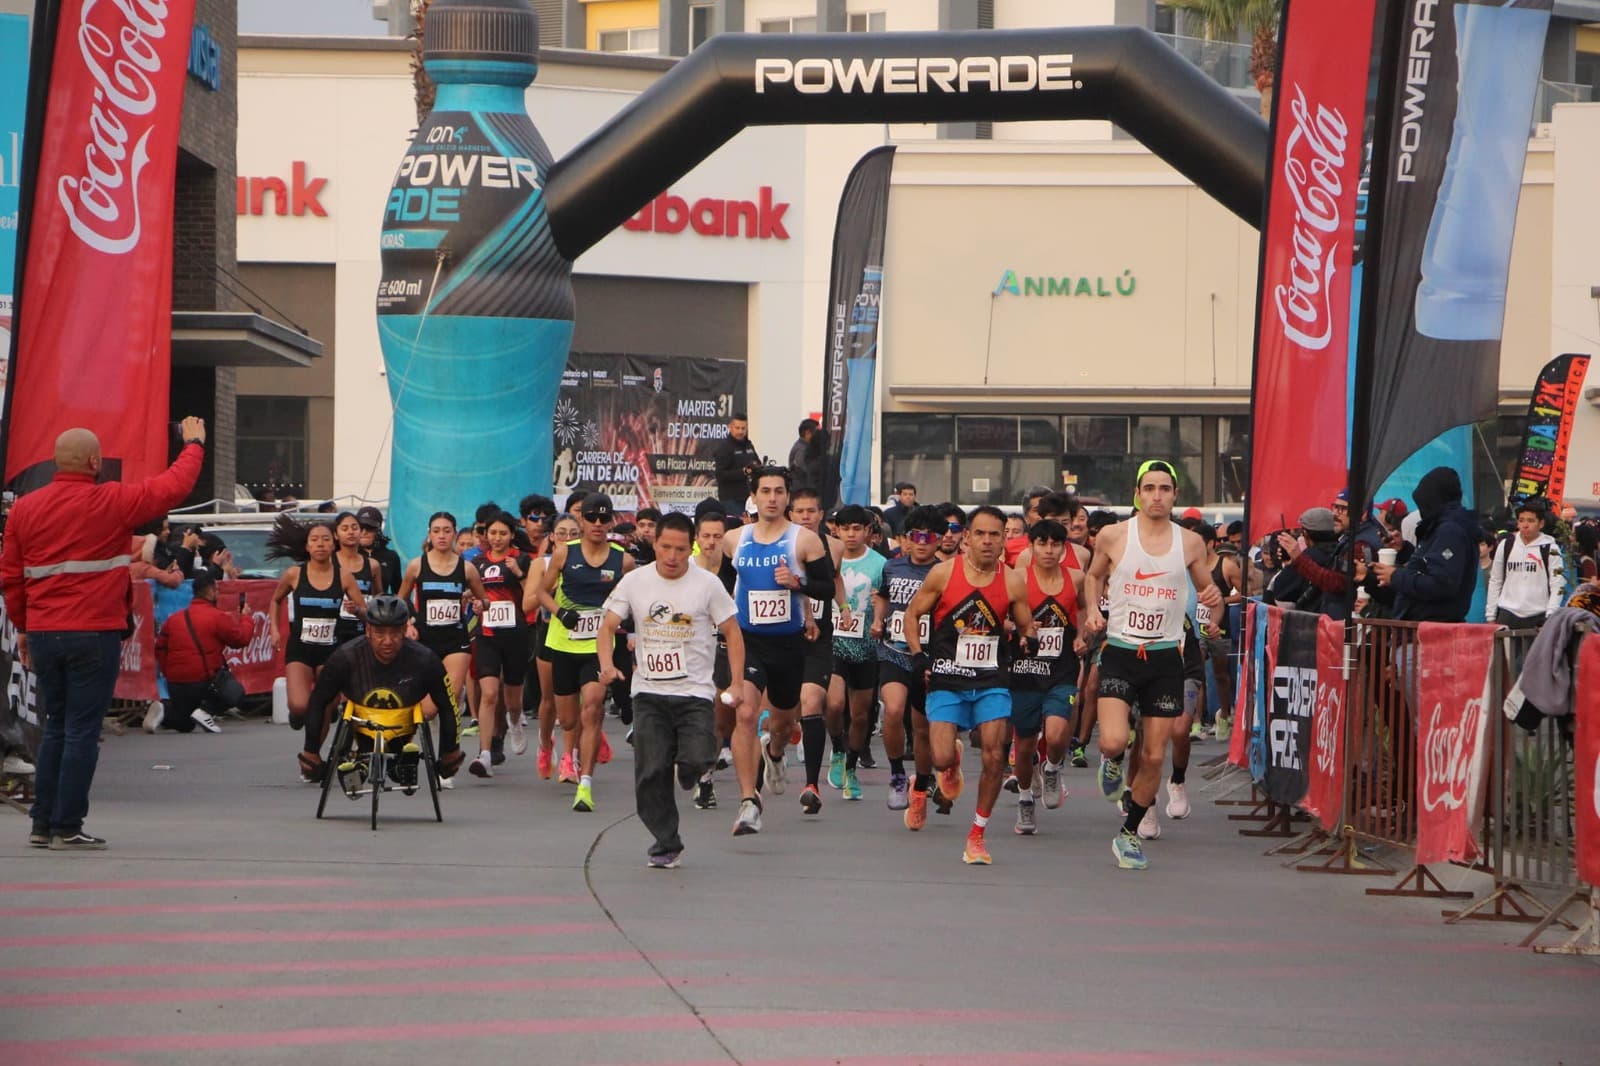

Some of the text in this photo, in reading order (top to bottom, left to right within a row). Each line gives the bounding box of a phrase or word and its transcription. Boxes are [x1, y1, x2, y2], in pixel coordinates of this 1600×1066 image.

[755, 54, 1074, 93] POWERADE
[394, 154, 542, 190] POWER
[1274, 81, 1348, 350] Coca-Cola
[388, 280, 406, 295] 600
[406, 280, 422, 295] ml
[831, 302, 847, 430] POWERADE
[677, 394, 733, 417] MARTES 31
[667, 422, 730, 439] DE DICIEMBR
[576, 451, 624, 464] CARRERA DE
[656, 459, 666, 470] en
[667, 458, 687, 470] Plaza
[577, 464, 639, 482] FIN DE AÑO
[1124, 583, 1178, 601] STOP PRE
[430, 605, 459, 620] 0642
[487, 607, 510, 622] 1201
[752, 599, 787, 618] 1223
[1128, 611, 1164, 631] 0387
[964, 642, 992, 661] 1181
[647, 652, 681, 673] 0681
